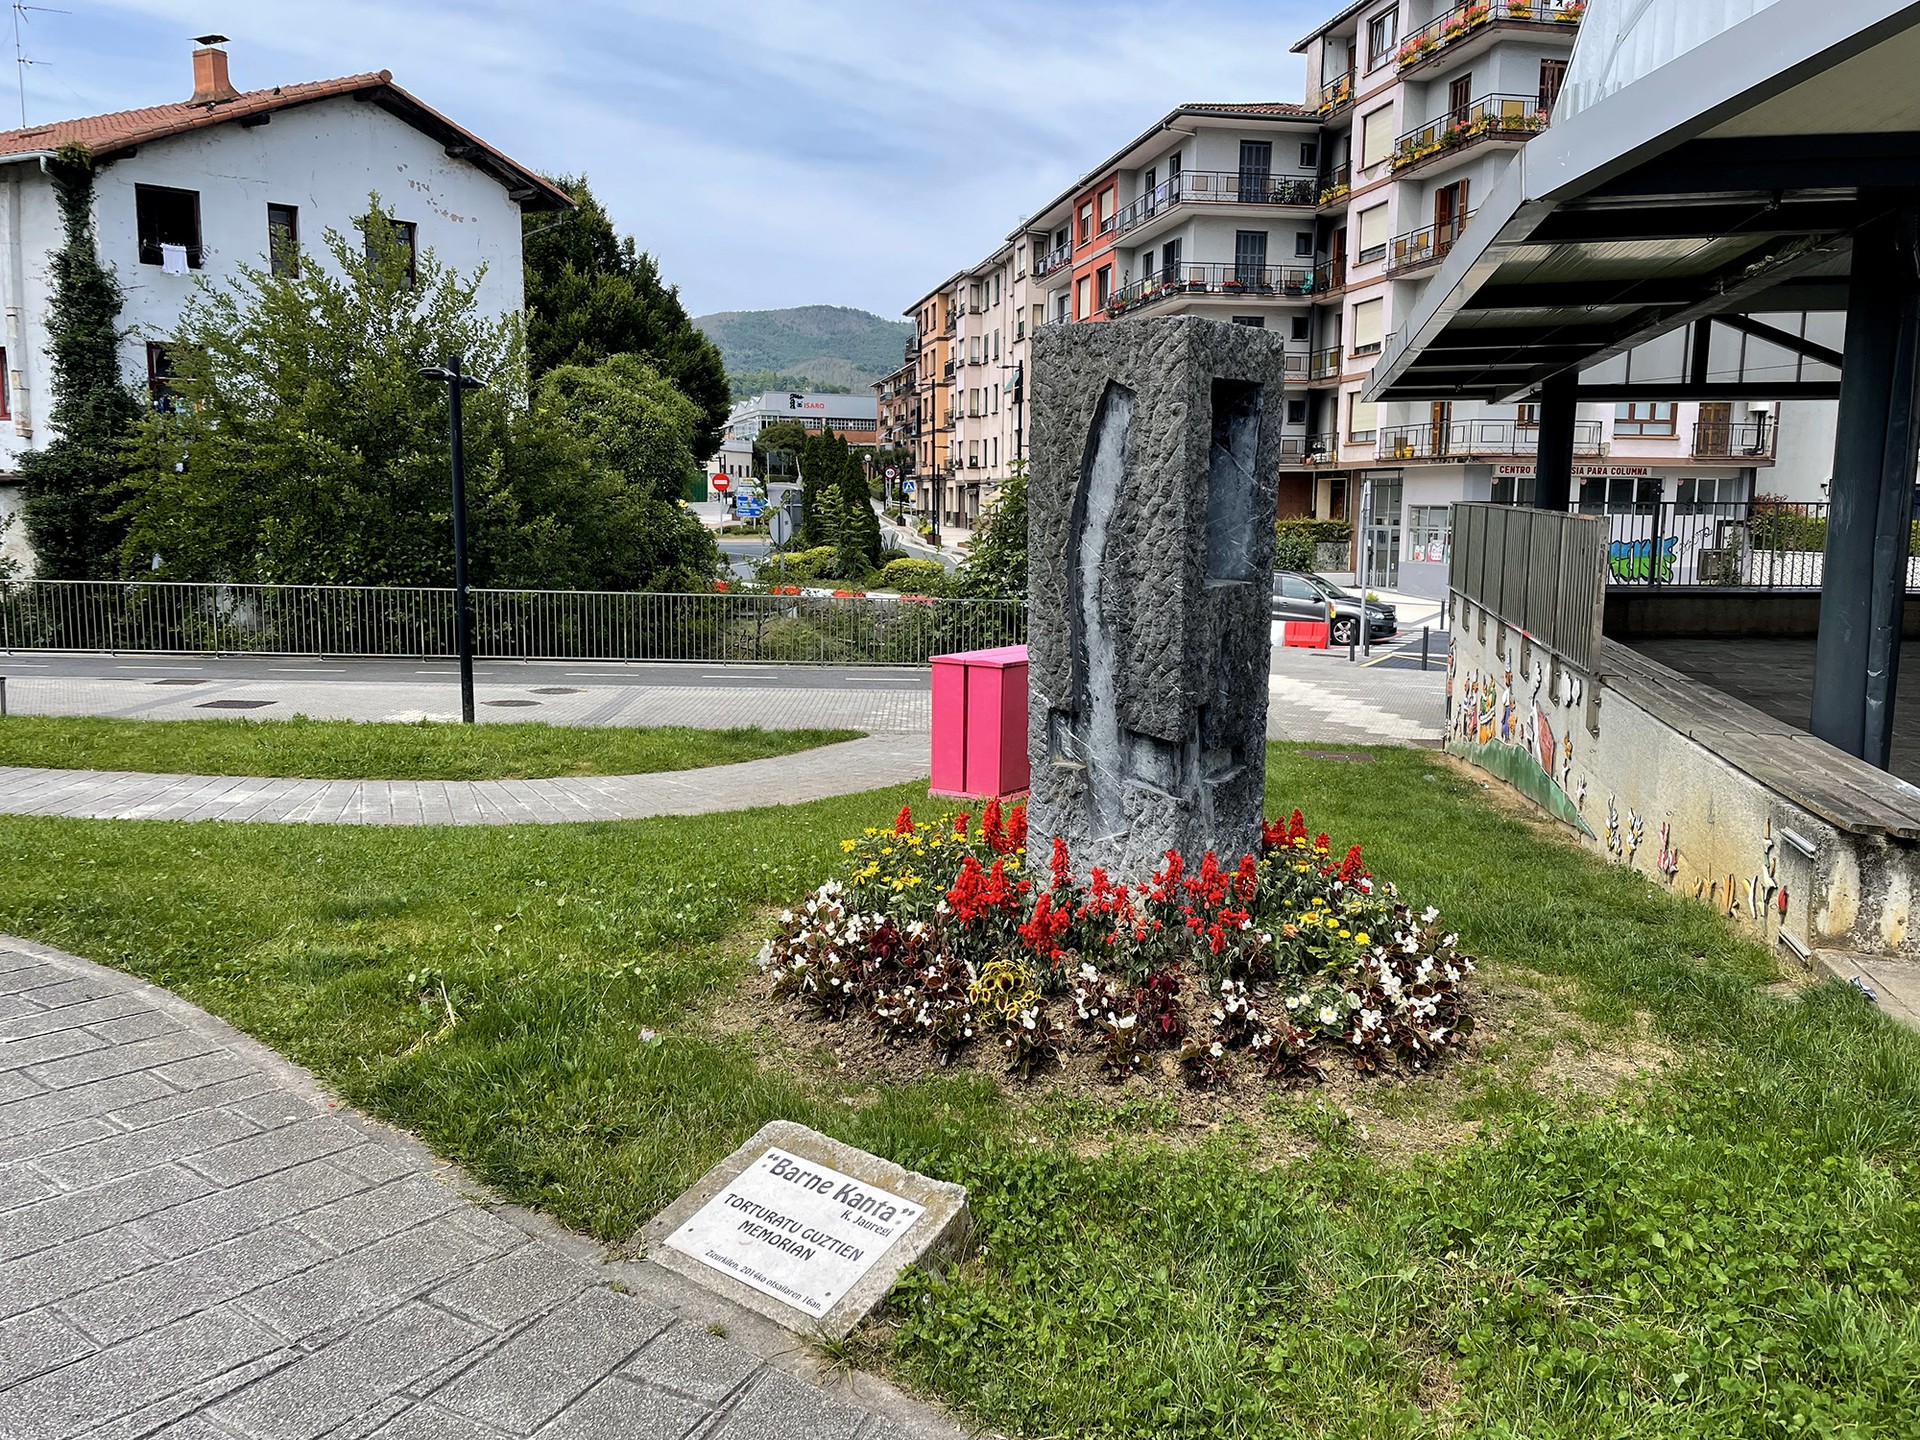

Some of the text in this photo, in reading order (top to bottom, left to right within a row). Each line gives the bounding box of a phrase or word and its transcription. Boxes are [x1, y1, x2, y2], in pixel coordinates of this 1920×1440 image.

[1499, 465, 1531, 474] CENTRO
[1587, 466, 1608, 475] PARA
[1610, 466, 1648, 476] COLUMNA
[724, 1193, 865, 1261] TORTURATU GUZTIEN
[737, 1220, 816, 1261] MEMORIAN
[840, 1209, 894, 1237] K. Jauregi
[705, 1249, 739, 1270] Zizurkilen,
[740, 1266, 766, 1282] 2014ko
[766, 1279, 802, 1300] otsailaren
